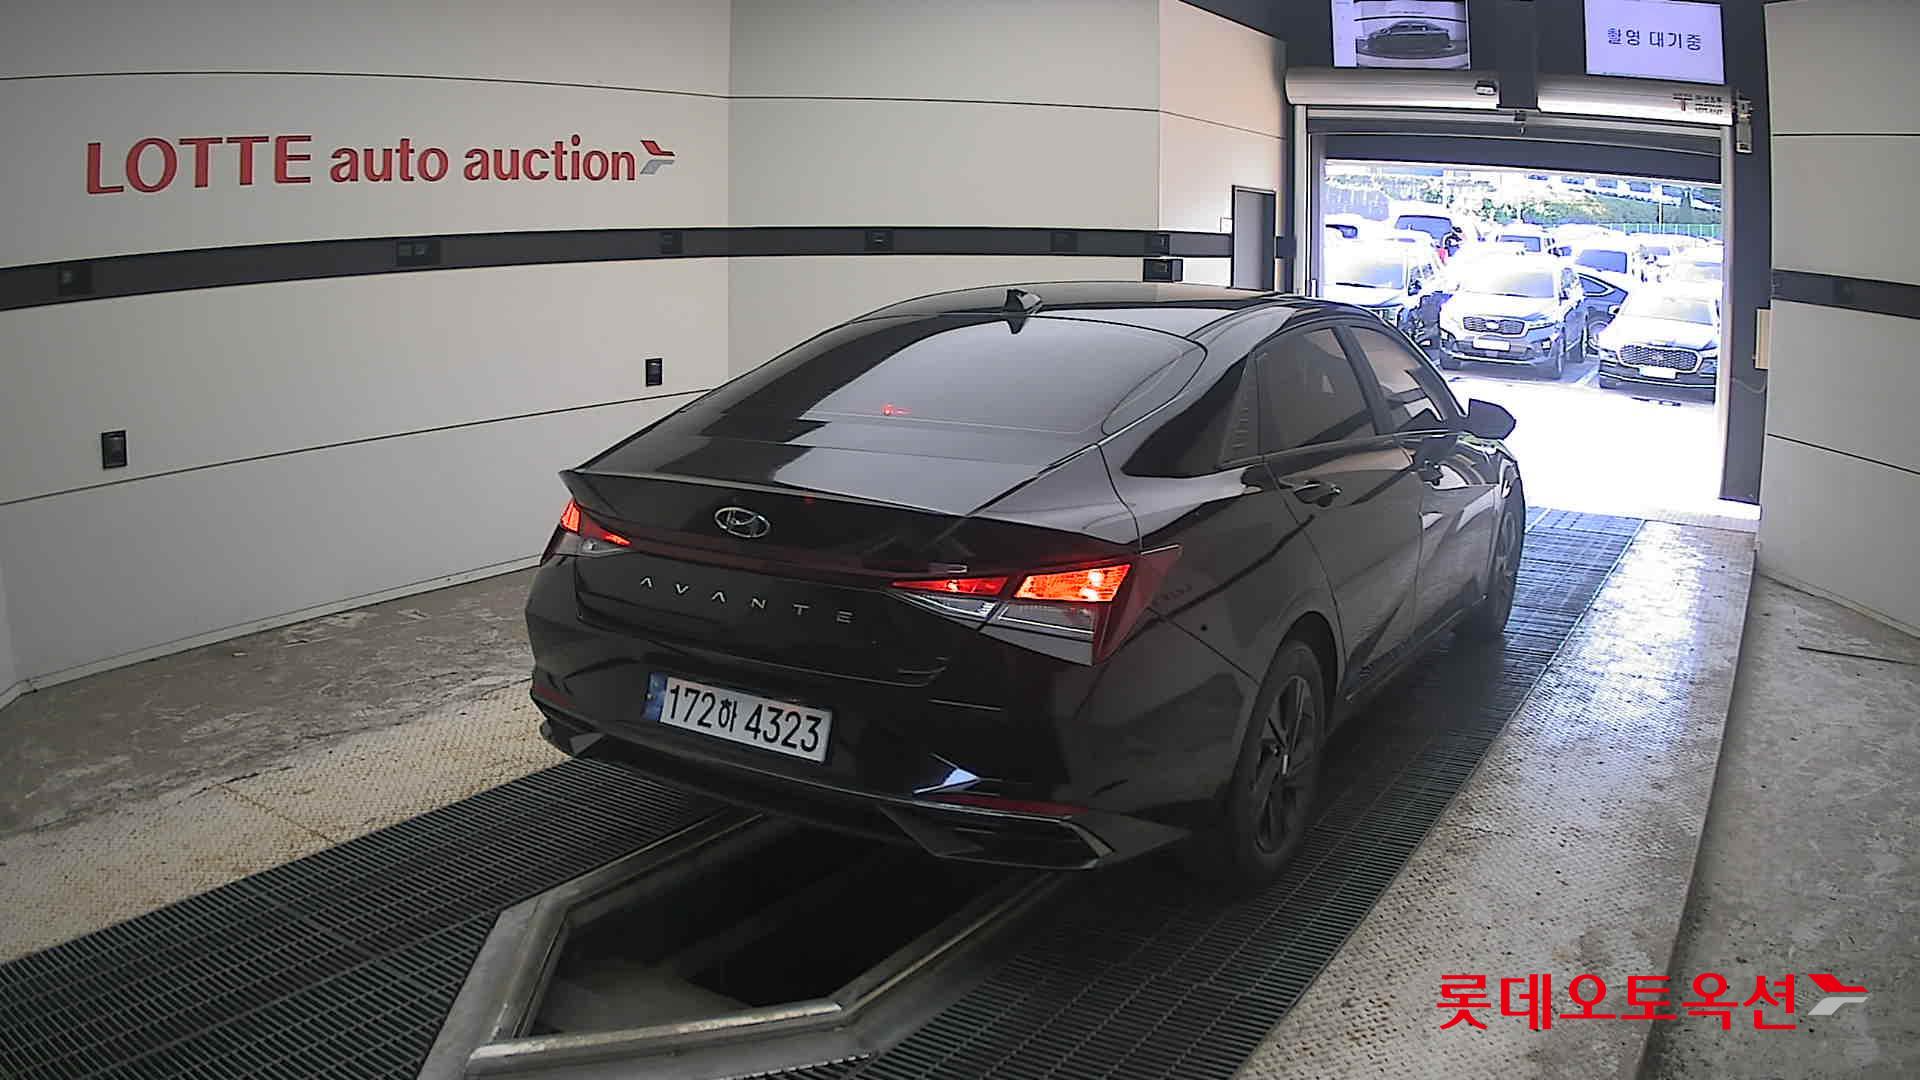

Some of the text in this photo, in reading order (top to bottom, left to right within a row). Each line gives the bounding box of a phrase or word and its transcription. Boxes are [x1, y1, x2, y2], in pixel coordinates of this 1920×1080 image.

[1649, 31, 1682, 49] 대기
[1687, 33, 1702, 51] 중
[86, 133, 638, 194] LOTTE auto auction
[640, 576, 854, 624] AVANTE
